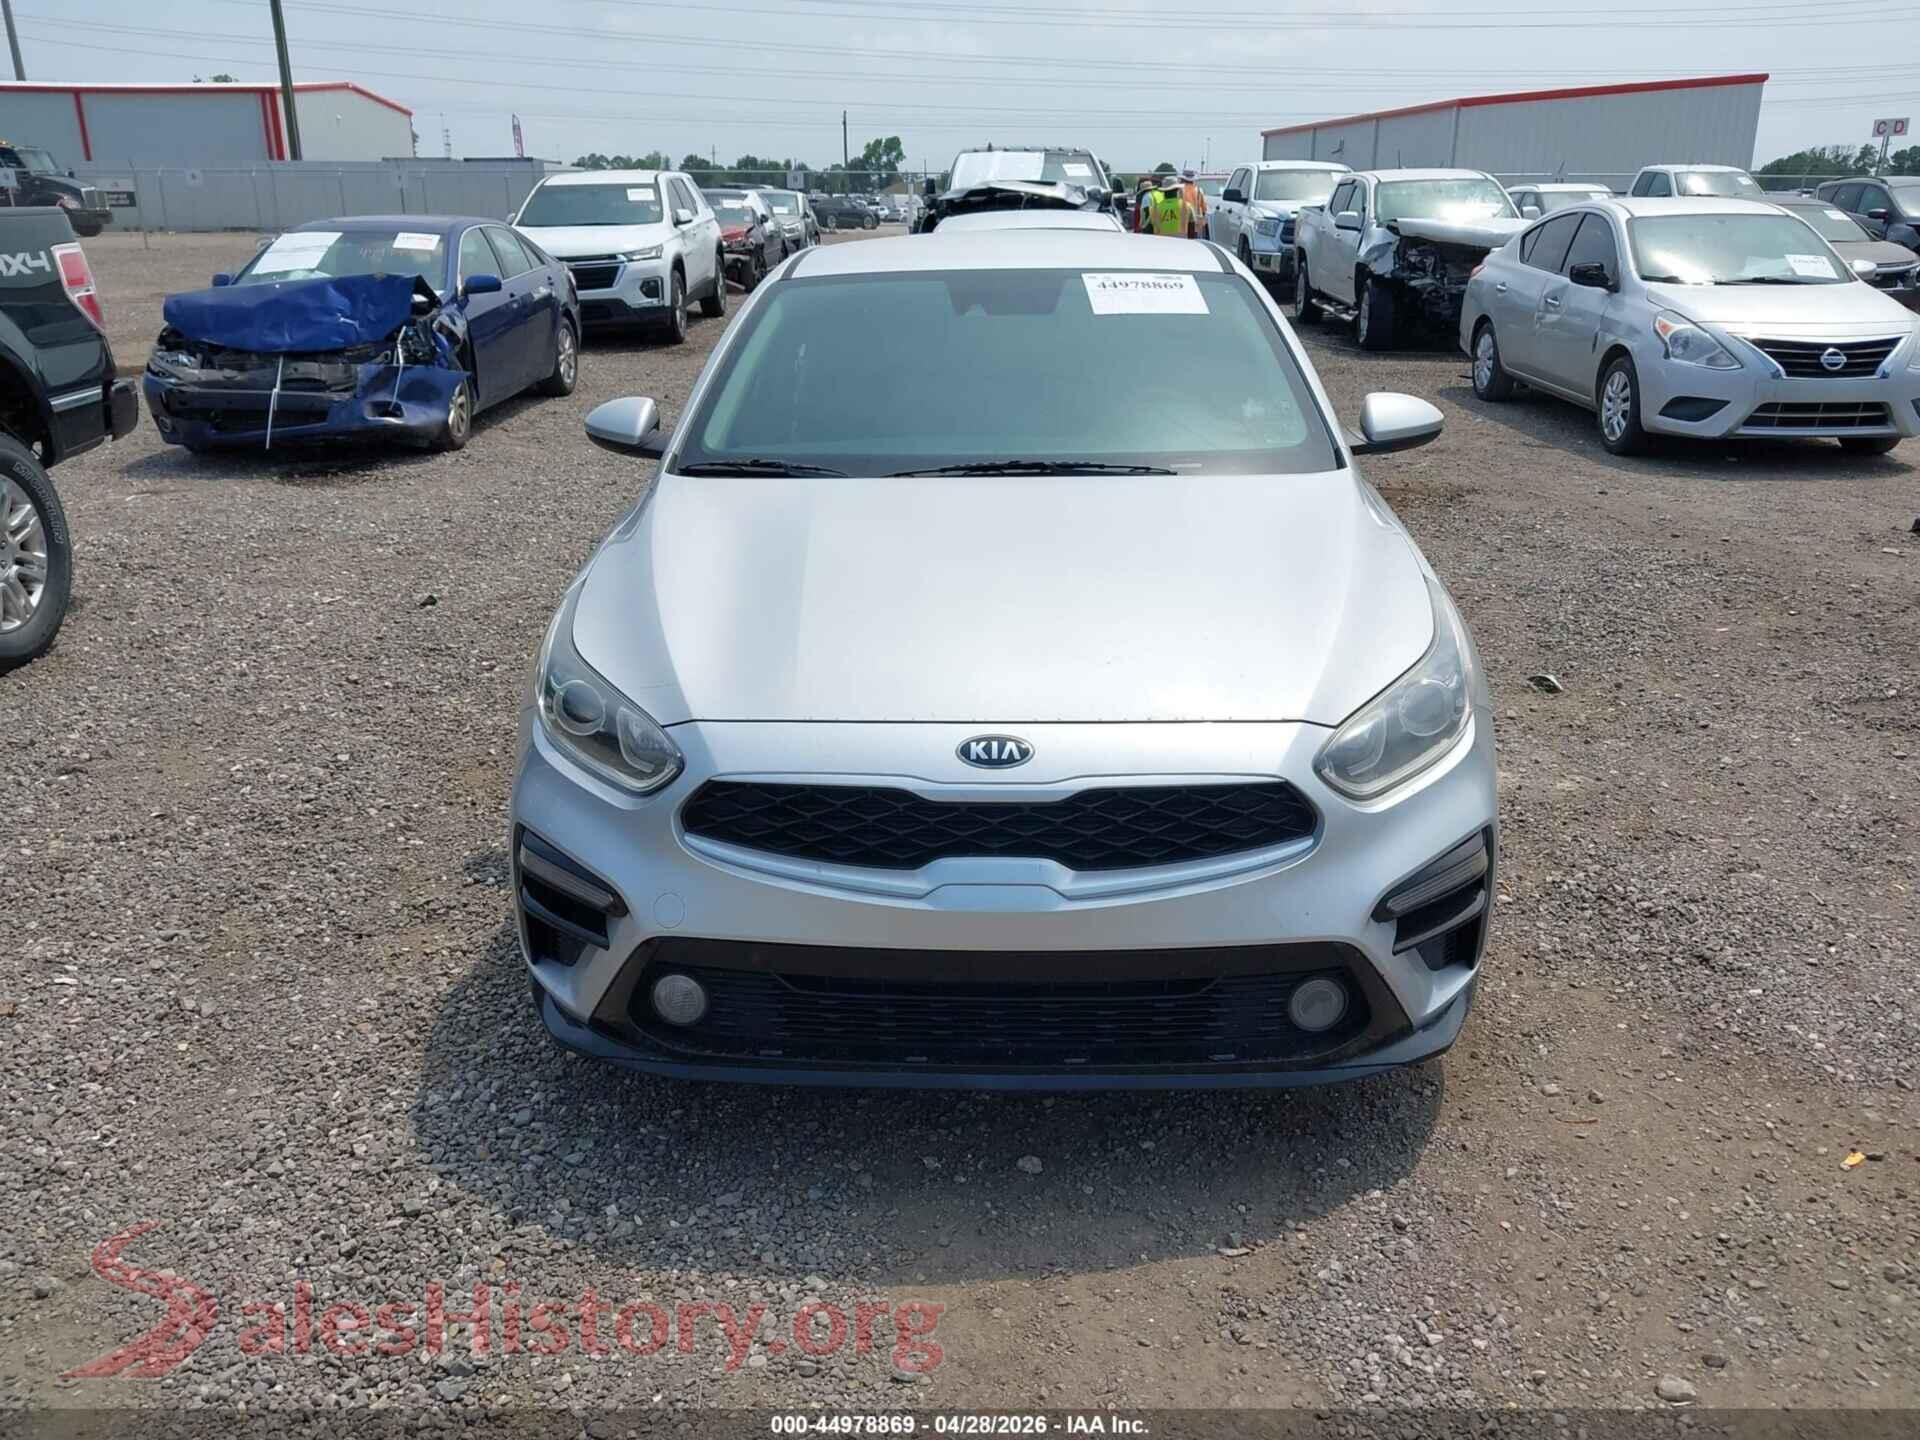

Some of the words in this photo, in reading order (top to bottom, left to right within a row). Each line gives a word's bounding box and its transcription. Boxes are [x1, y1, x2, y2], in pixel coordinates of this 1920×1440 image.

[1876, 120, 1888, 135] C
[1894, 119, 1905, 134] D
[1097, 280, 1184, 290] 44978869
[969, 740, 1021, 760] KIA
